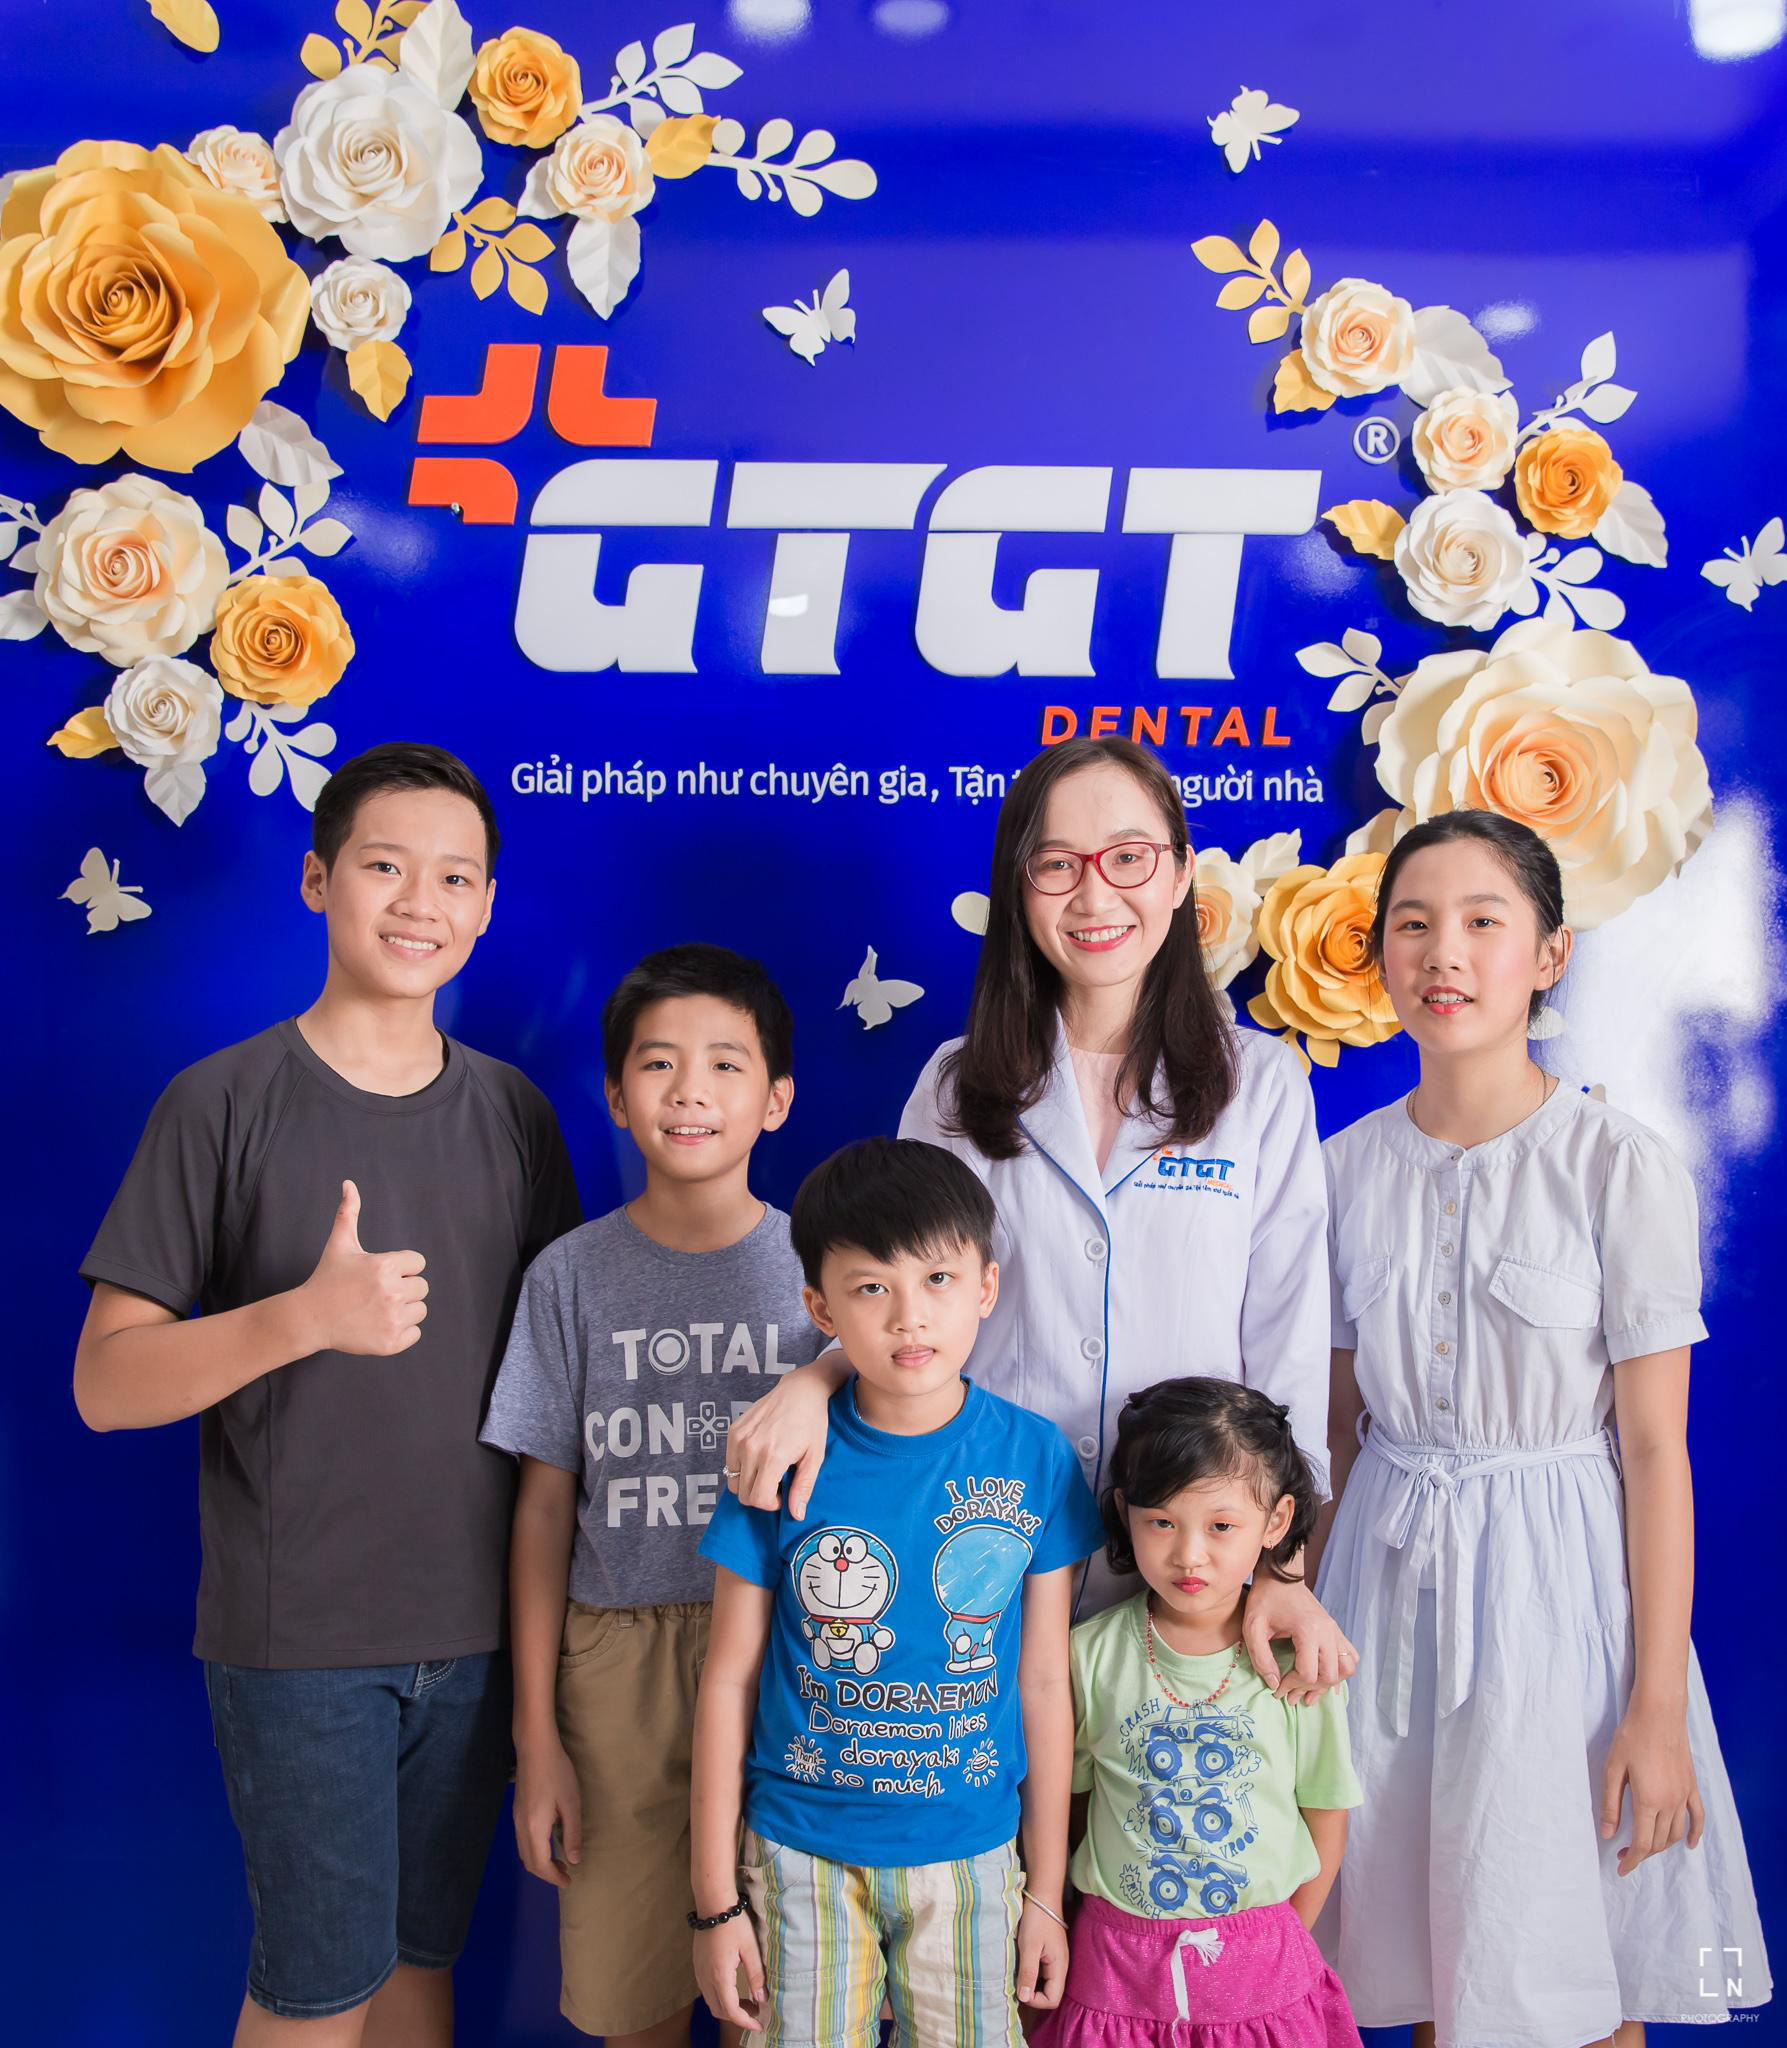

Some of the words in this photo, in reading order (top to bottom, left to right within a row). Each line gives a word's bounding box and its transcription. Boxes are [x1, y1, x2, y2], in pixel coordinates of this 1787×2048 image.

[514, 458, 1322, 680] GTGT
[1041, 705, 1291, 746] DENTAL
[511, 754, 573, 795] Giải
[582, 760, 667, 803] pháp
[677, 761, 743, 796] như
[750, 763, 869, 804] chuyên
[878, 765, 939, 804] gia,
[948, 765, 1005, 805] Tận
[1263, 765, 1324, 803] nhà
[1158, 1156, 1235, 1181] GTGT
[611, 1322, 796, 1381] TOTAL
[607, 1473, 719, 1528] FRE
[944, 1480, 964, 1505] I
[966, 1476, 1026, 1505] LOVE
[934, 1497, 1042, 1536] DORAYAKI
[797, 1665, 828, 1702] I'm
[835, 1670, 998, 1714] DORAEMON
[809, 1702, 942, 1740] Doraemon
[949, 1713, 987, 1740] likes
[1119, 1697, 1160, 1738] CRASH
[840, 1738, 960, 1776] dorayaki
[832, 1770, 864, 1787] so
[1124, 1874, 1161, 1920] CRUNCH
